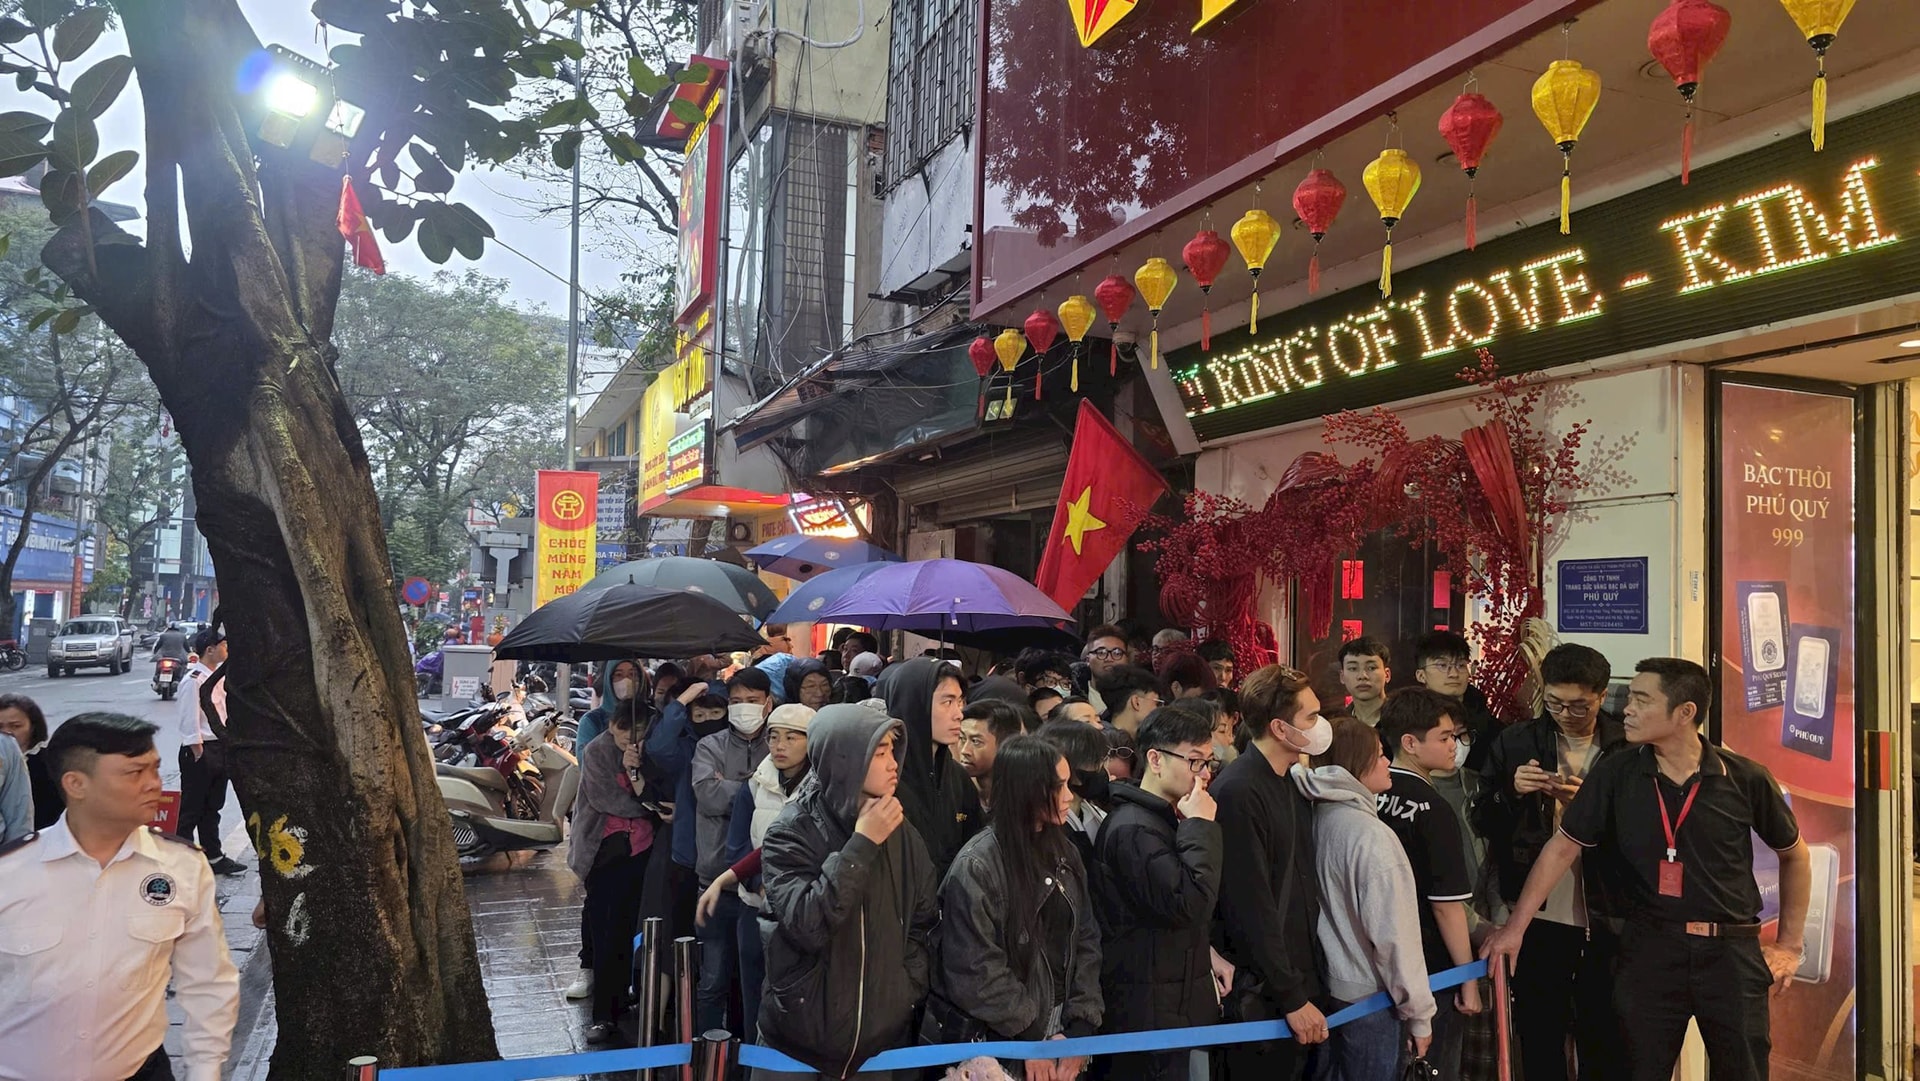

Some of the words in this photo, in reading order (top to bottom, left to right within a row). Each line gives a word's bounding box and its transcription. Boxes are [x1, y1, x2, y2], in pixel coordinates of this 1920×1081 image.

[1206, 326, 1324, 410] RING
[1327, 306, 1399, 378] OF
[1389, 248, 1606, 361] LOVE
[1658, 157, 1900, 296] KIM
[1743, 462, 1783, 488] BẠC
[1785, 465, 1832, 489] THỎI
[1746, 493, 1786, 516] PHÚ
[1790, 496, 1830, 522] QUÝ
[548, 537, 587, 549] CHÚC
[1772, 527, 1804, 547] 999
[547, 552, 587, 564] MỪNG
[552, 568, 582, 579] NĂM
[1584, 591, 1599, 600] PHÚ
[1603, 591, 1619, 600] QUÝ
[1376, 793, 1430, 822] ナルズ
